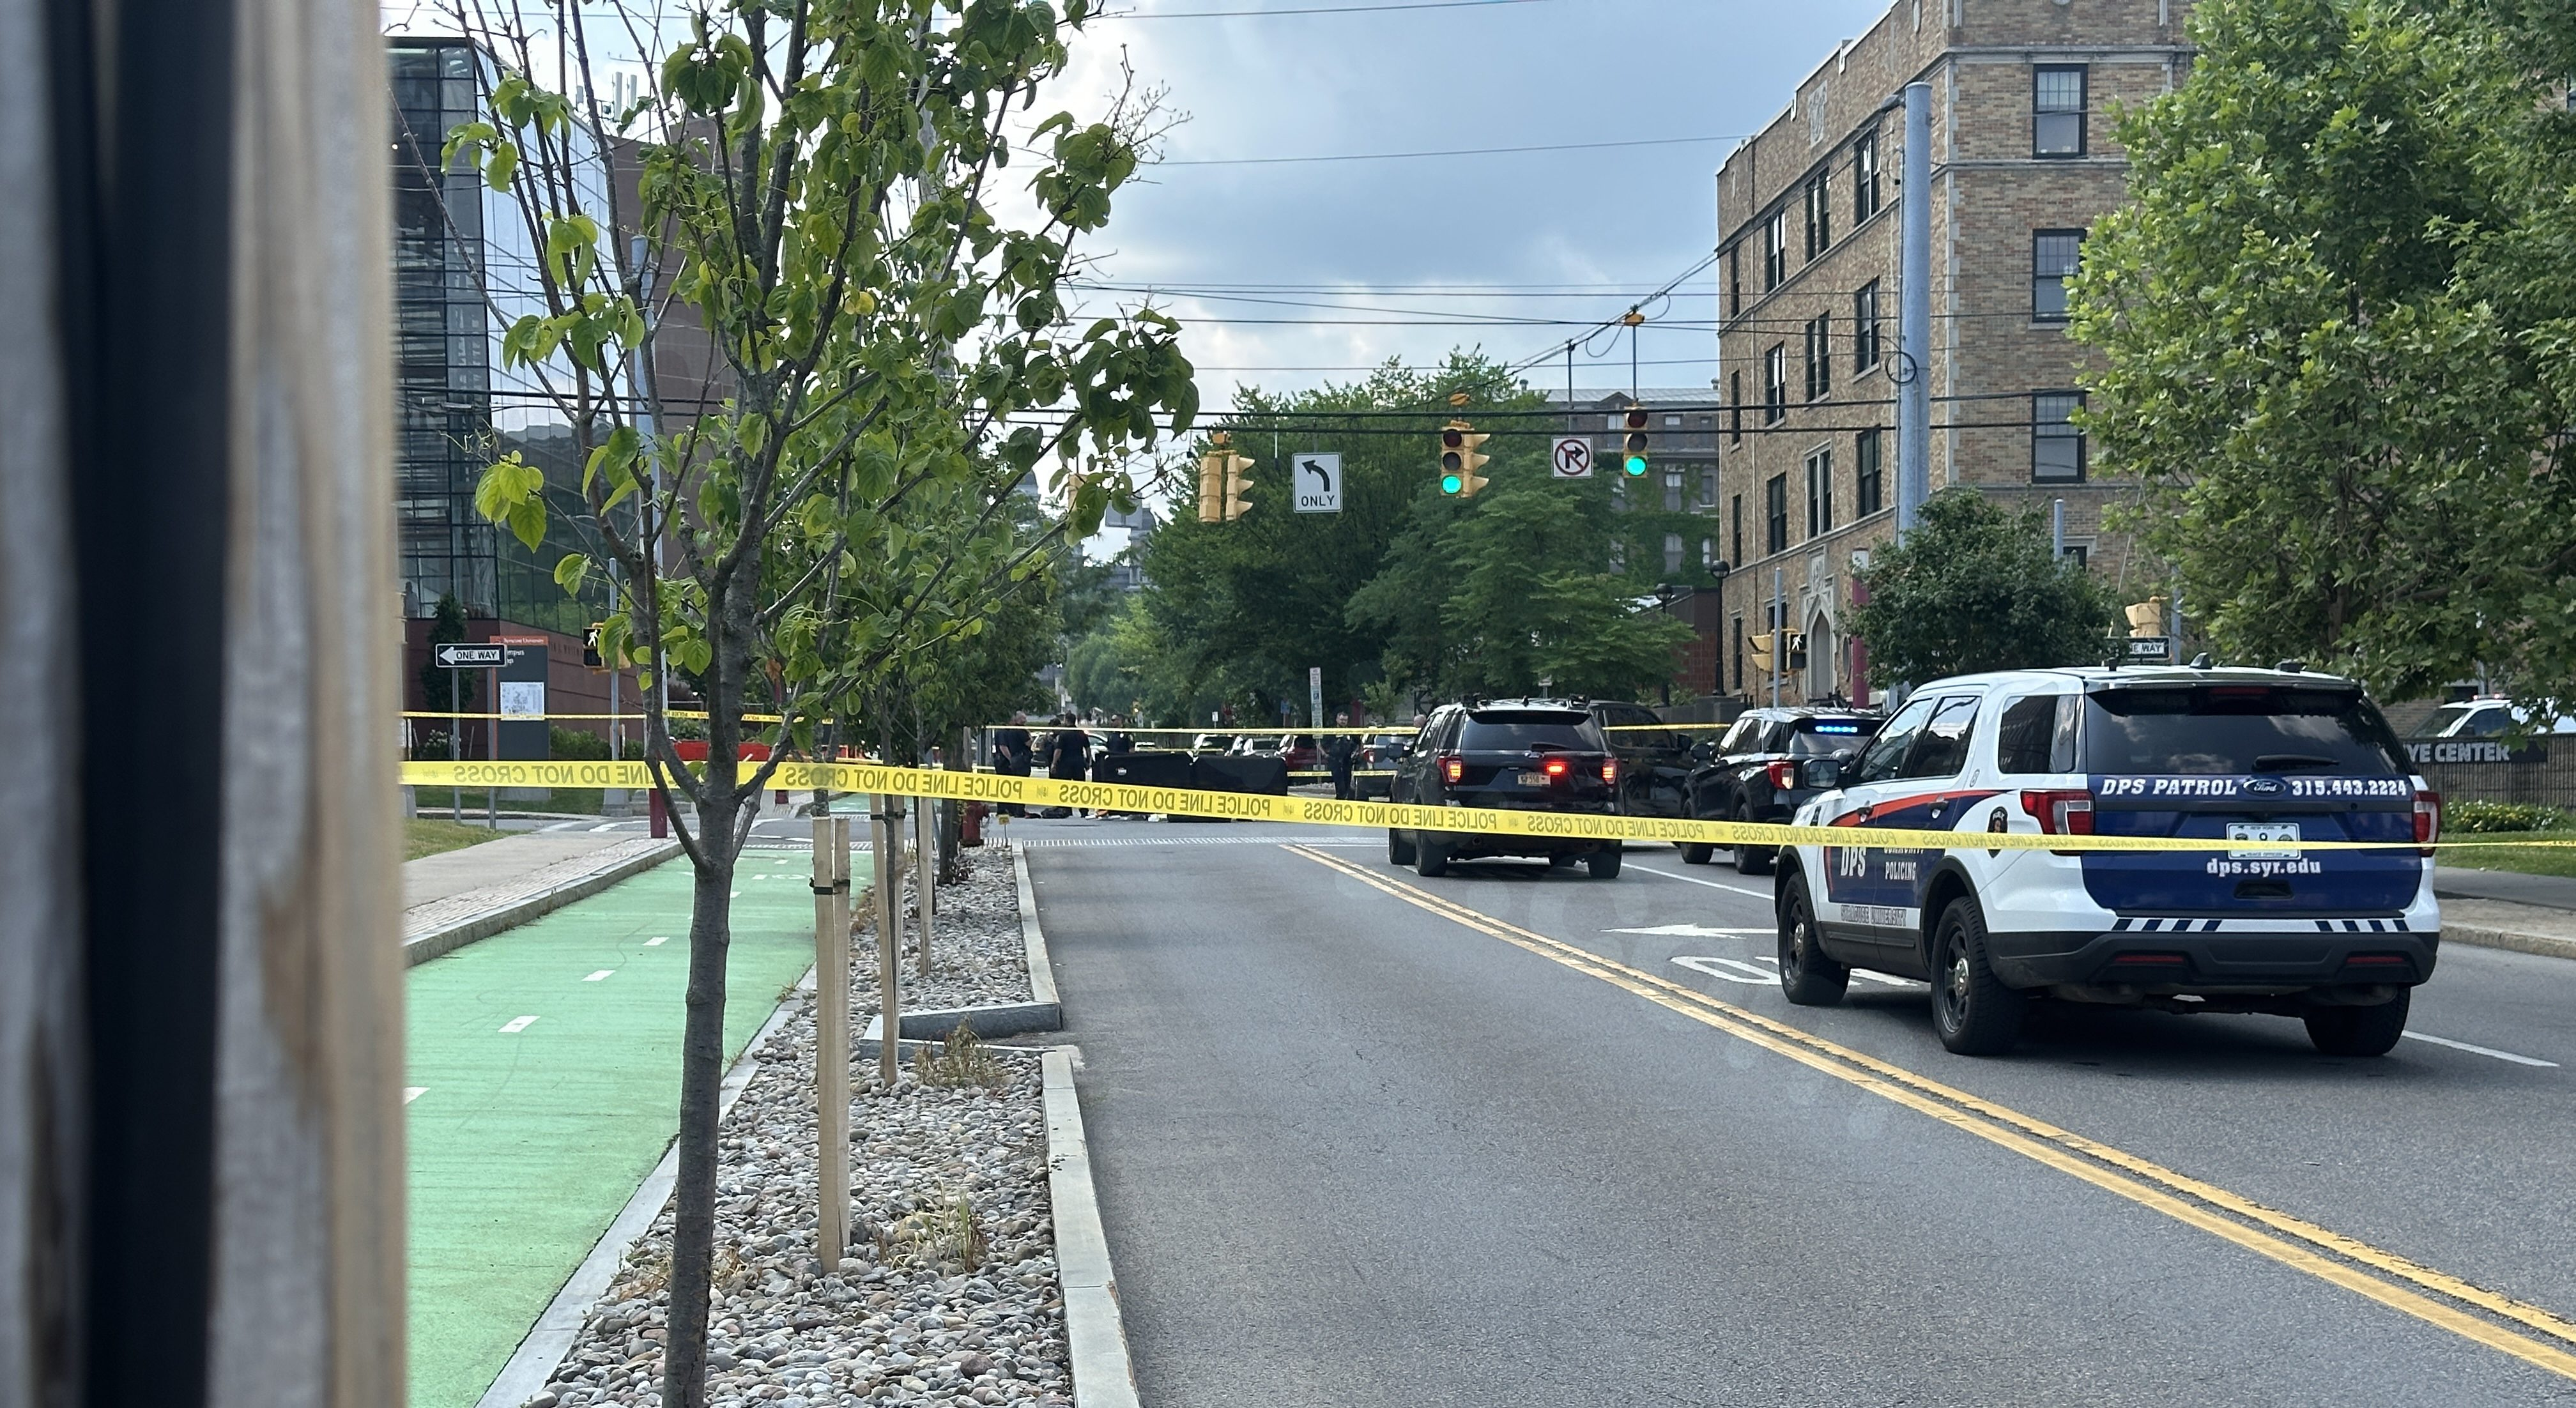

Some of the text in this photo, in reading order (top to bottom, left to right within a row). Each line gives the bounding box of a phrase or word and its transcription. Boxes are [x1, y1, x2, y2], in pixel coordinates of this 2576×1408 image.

[1301, 495, 1335, 507] ONLY
[456, 650, 496, 659] ONE WAY
[2142, 643, 2161, 652] WAY
[2404, 743, 2431, 763] YE
[2101, 779, 2237, 795] DPS PATROL
[2253, 781, 2277, 792] Ford
[2292, 779, 2407, 796] 315.443.2224
[1841, 846, 1866, 877] DPS
[2206, 858, 2321, 878] dps.syr.edu
[1885, 861, 1916, 880] POLICING
[1871, 907, 1906, 927] UNIVERSITY
